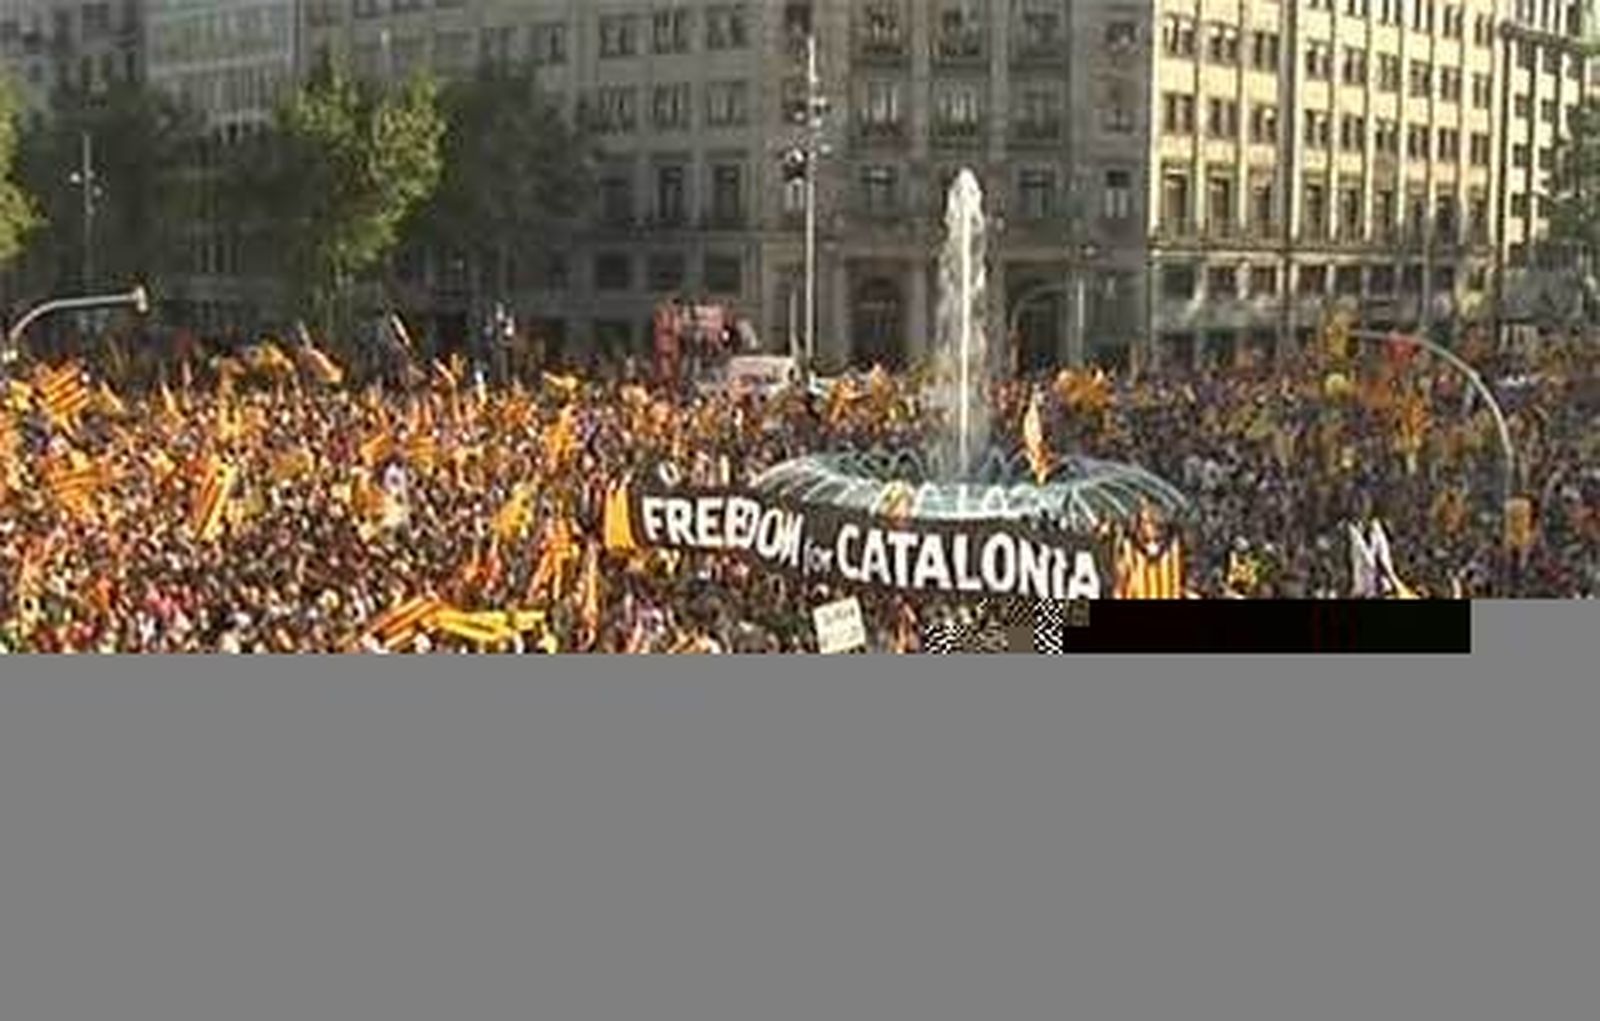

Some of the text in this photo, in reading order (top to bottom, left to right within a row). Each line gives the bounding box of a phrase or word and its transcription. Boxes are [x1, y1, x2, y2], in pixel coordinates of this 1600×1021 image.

[643, 497, 1100, 600] FREEDOM for CATALONIA
